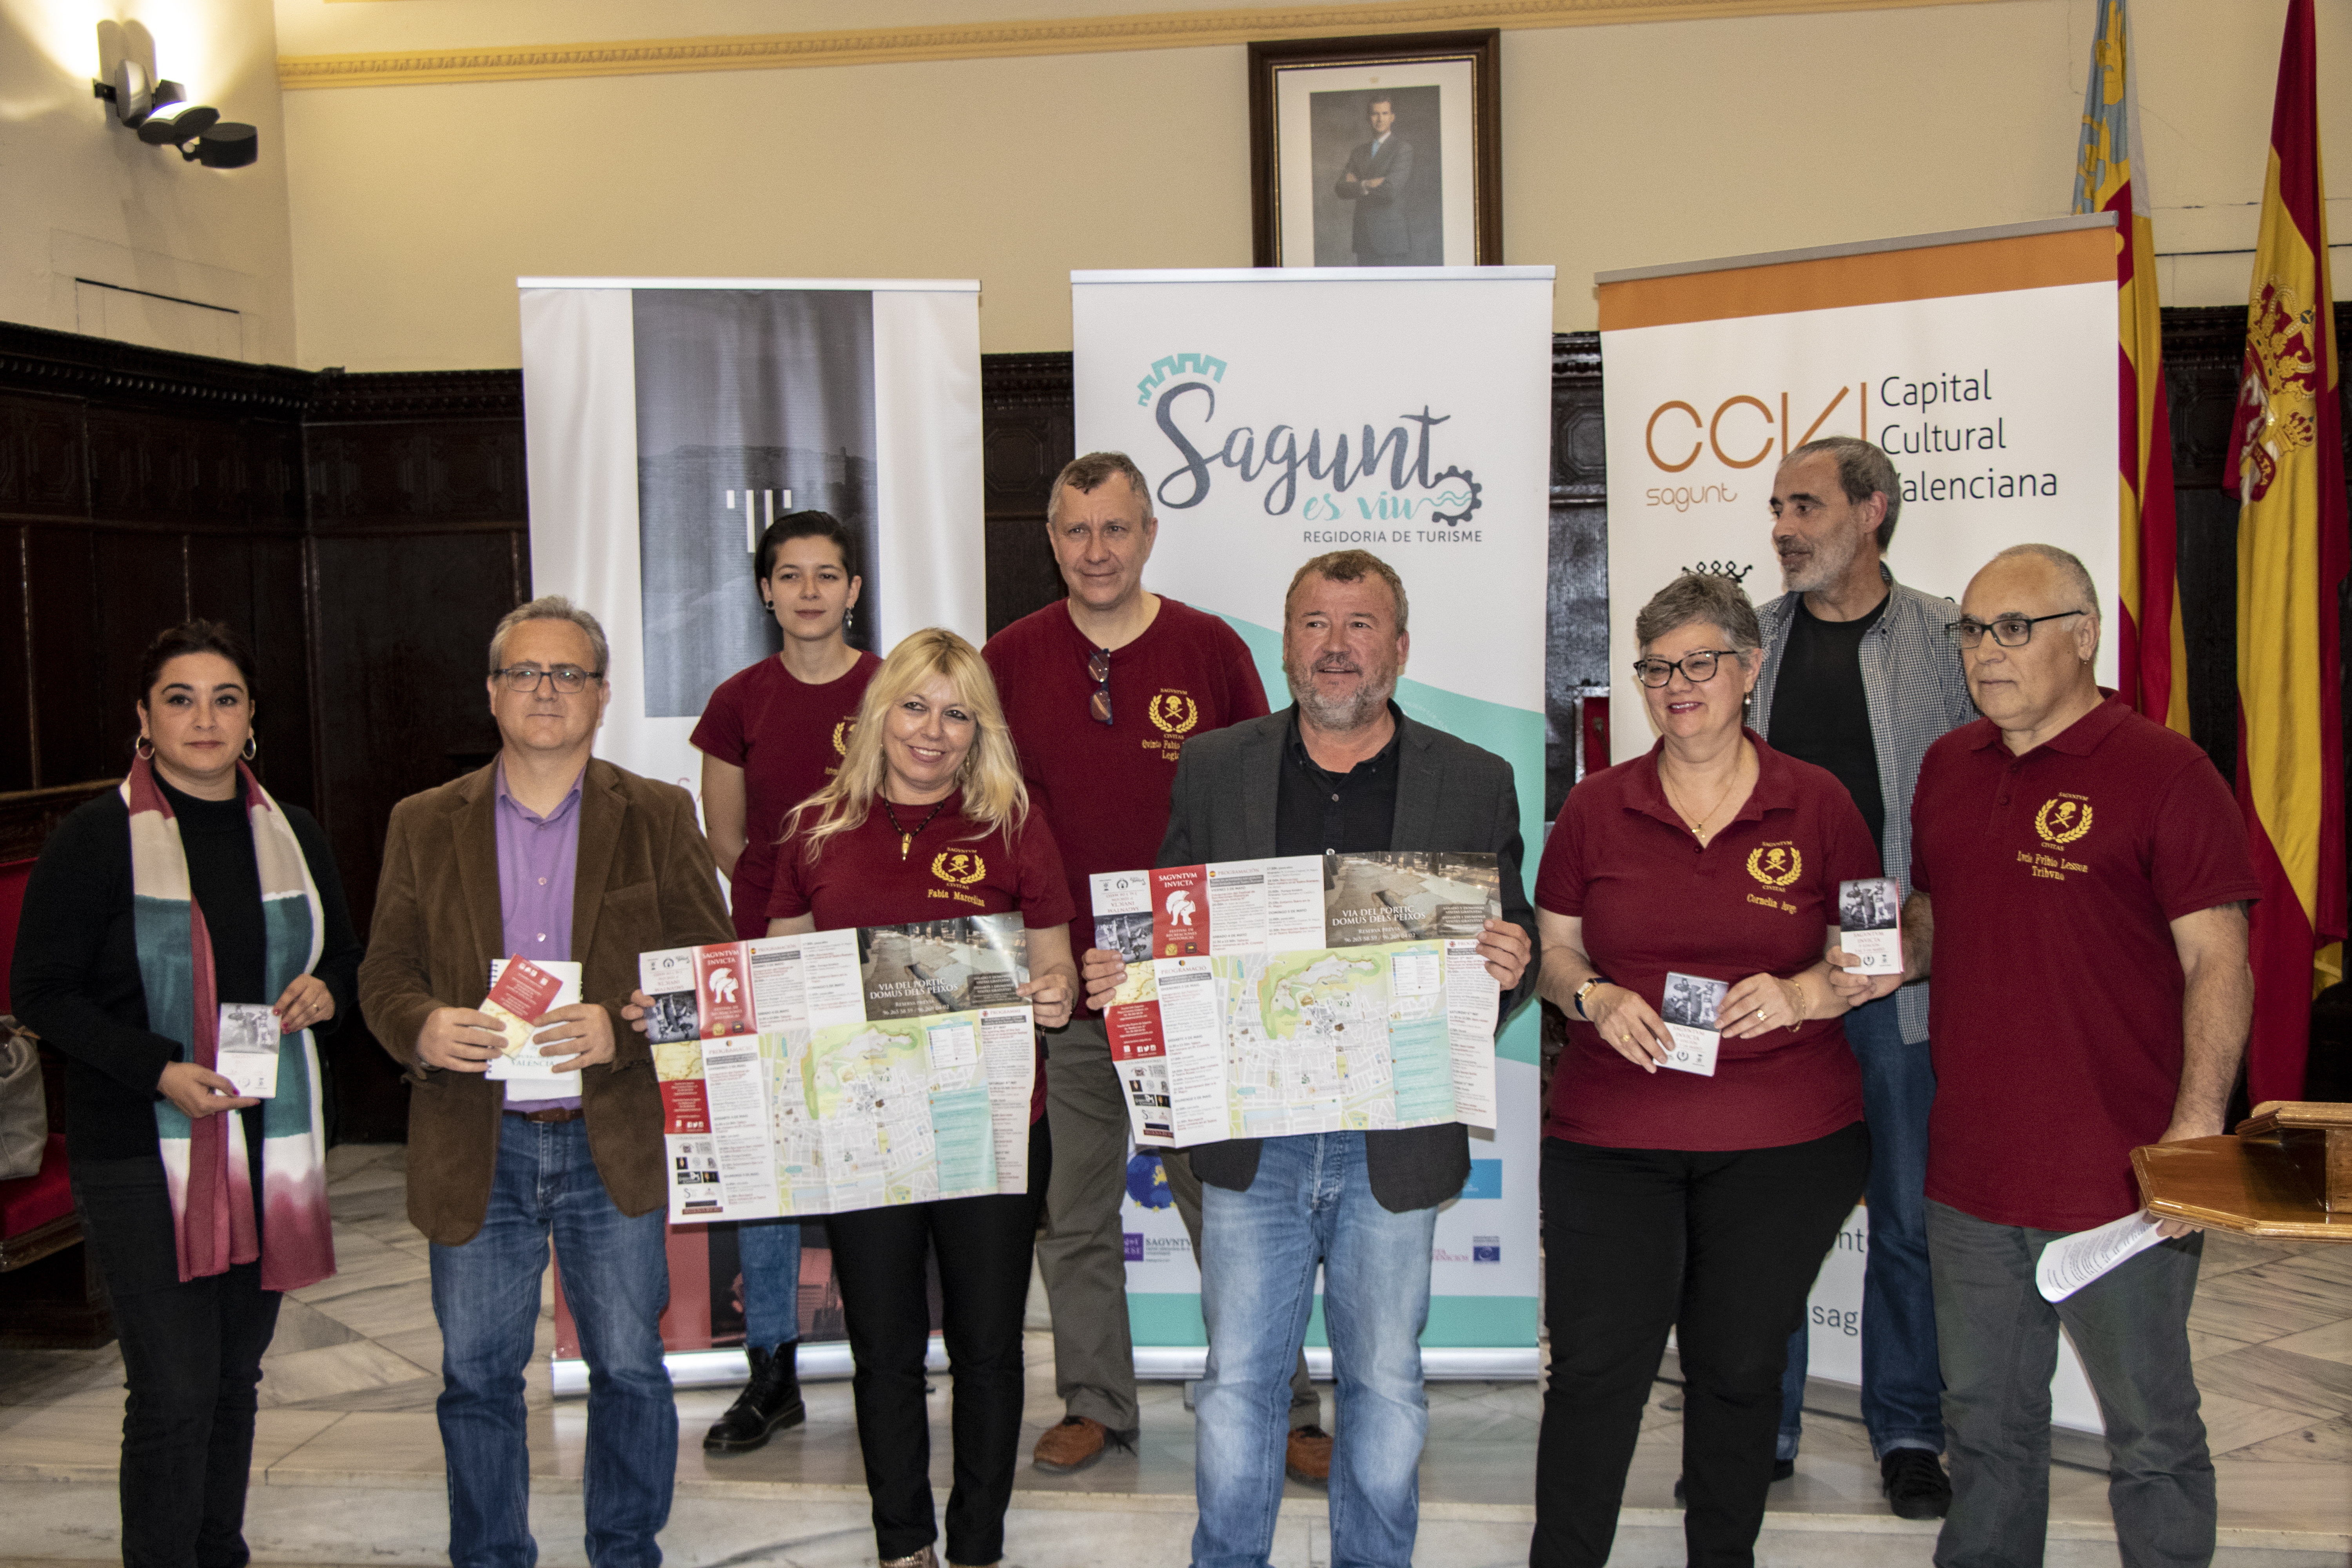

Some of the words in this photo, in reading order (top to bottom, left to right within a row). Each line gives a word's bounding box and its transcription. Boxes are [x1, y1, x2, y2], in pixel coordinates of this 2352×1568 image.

[1880, 369, 1992, 414] Capital
[1880, 417, 2006, 456] Cultural
[1156, 382, 1451, 516] Sagunt
[1896, 468, 2058, 503] alenciana
[1646, 483, 1738, 512] sagunt
[1303, 493, 1343, 521] es
[1357, 491, 1415, 521] viu
[1303, 531, 1388, 543] REGIDORIA
[1392, 531, 1412, 543] DE
[1417, 530, 1483, 542] TURISME
[2041, 842, 2065, 851] CIVITAS
[1158, 872, 1198, 882] SAGVNTVM
[1164, 880, 1194, 888] INVICTA
[1332, 917, 1367, 926] DOMUS
[1369, 915, 1392, 924] DELS
[1394, 912, 1426, 921] PEIXOS
[1341, 909, 1357, 917] VIA
[707, 956, 736, 966] INVICTA
[869, 990, 903, 1000] DOMUS
[904, 988, 925, 996] DELS
[927, 984, 958, 994] PEIXOS
[878, 983, 894, 991] VIA
[1812, 1305, 1859, 1336] sag
